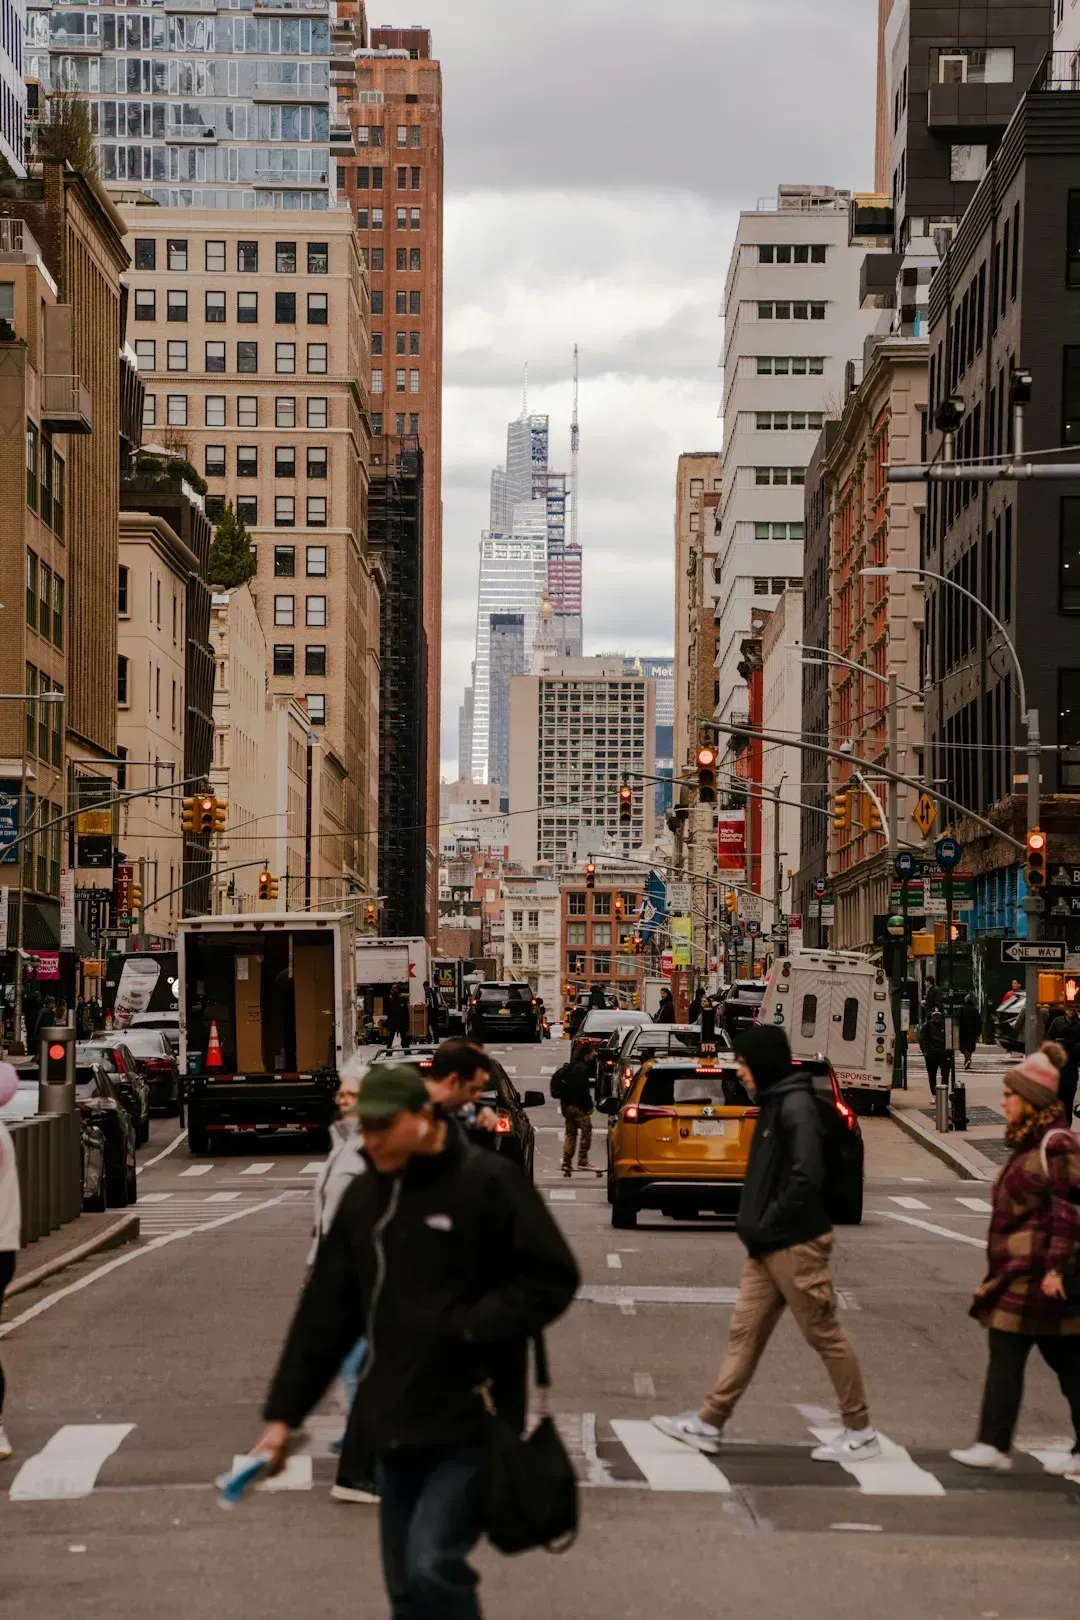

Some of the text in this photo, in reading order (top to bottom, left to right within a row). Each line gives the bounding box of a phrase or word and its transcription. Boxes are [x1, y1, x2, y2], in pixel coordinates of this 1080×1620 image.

[652, 666, 673, 676] Met
[923, 864, 942, 873] Park
[75, 892, 90, 900] urray
[1012, 947, 1058, 957] ONE WAY
[836, 1071, 873, 1082] ESPONSE
